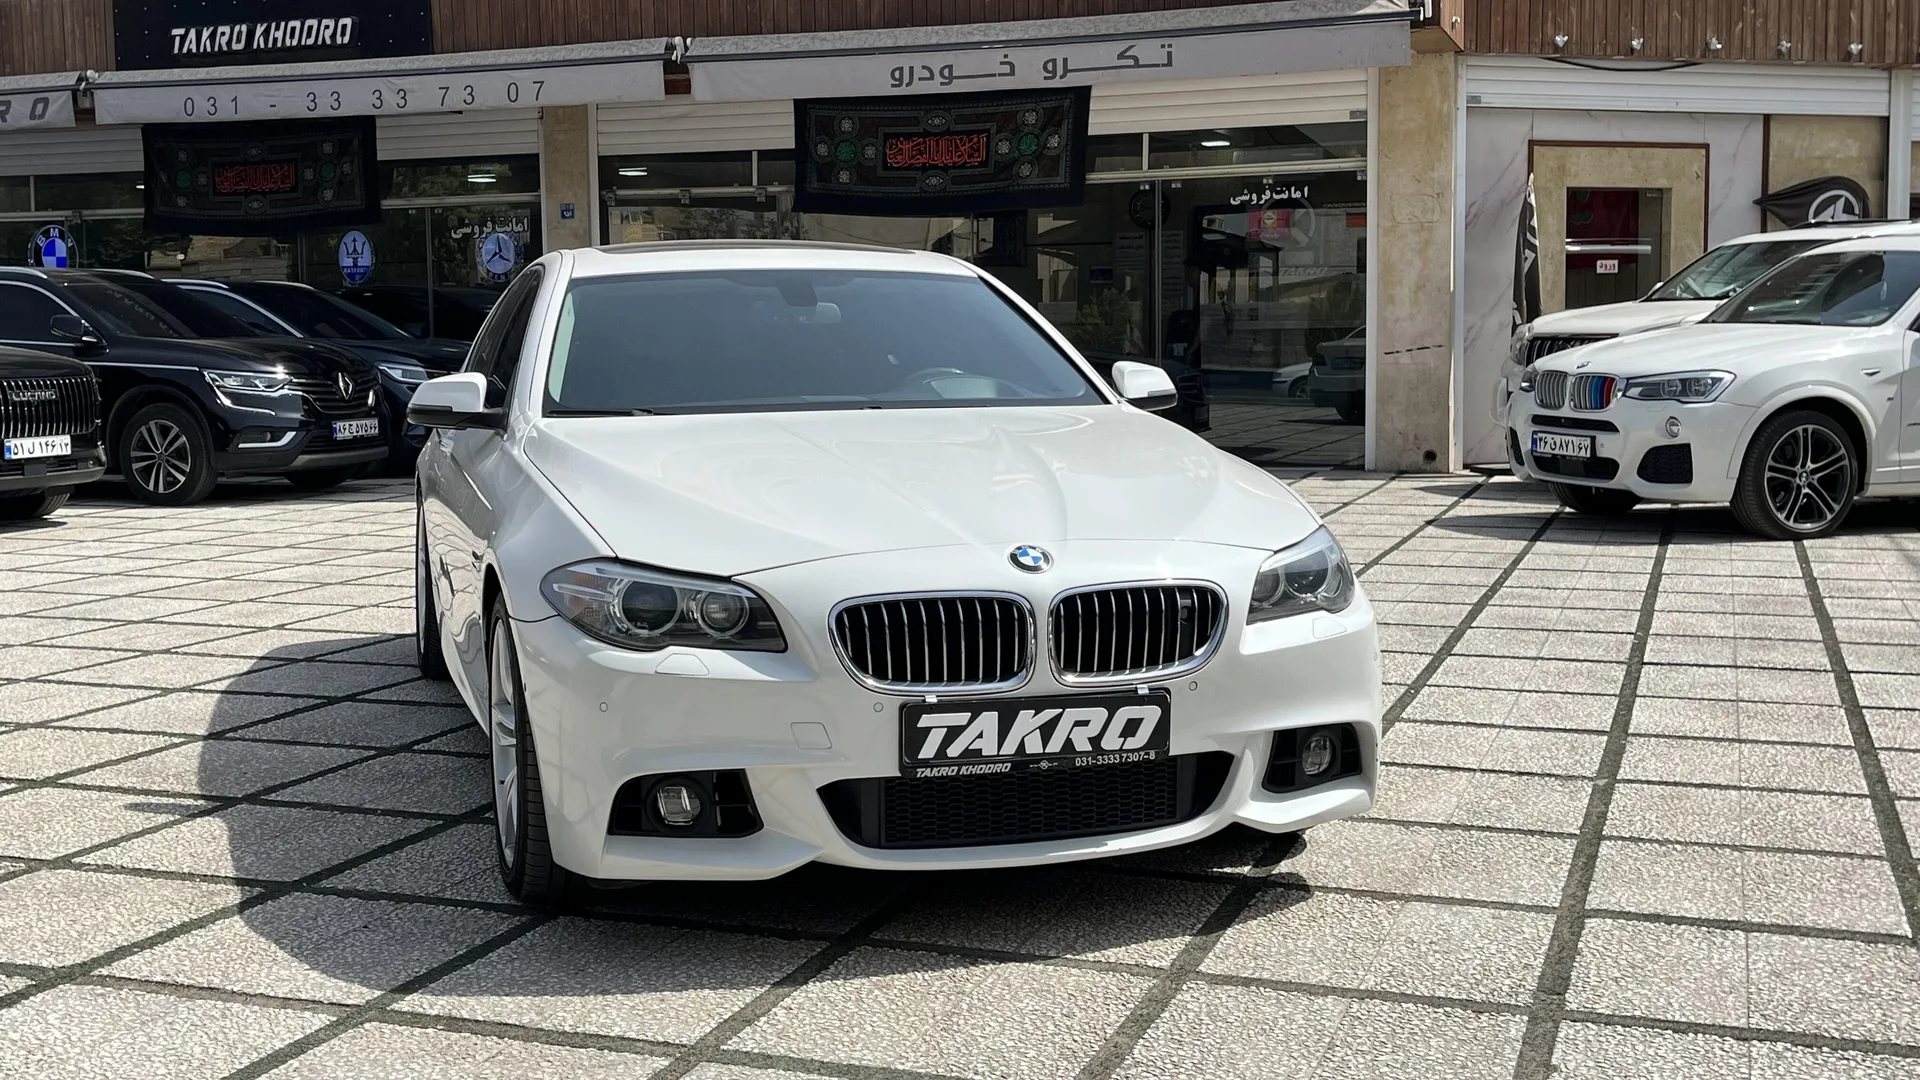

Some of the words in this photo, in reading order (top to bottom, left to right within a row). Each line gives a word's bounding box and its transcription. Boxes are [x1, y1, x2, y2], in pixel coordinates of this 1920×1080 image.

[171, 24, 248, 54] TAKRO
[253, 17, 352, 49] KHODRO
[890, 53, 1016, 88] خودرو
[1042, 43, 1173, 81] تکرو
[183, 95, 238, 117] 031
[306, 91, 342, 112] 33
[371, 89, 408, 110] 33
[438, 84, 476, 106] 73
[507, 80, 545, 103] 07
[1598, 261, 1616, 271] ورود
[916, 705, 1162, 760] TAKRO
[916, 766, 958, 778] TAKRO
[959, 763, 1012, 776] KHODRO
